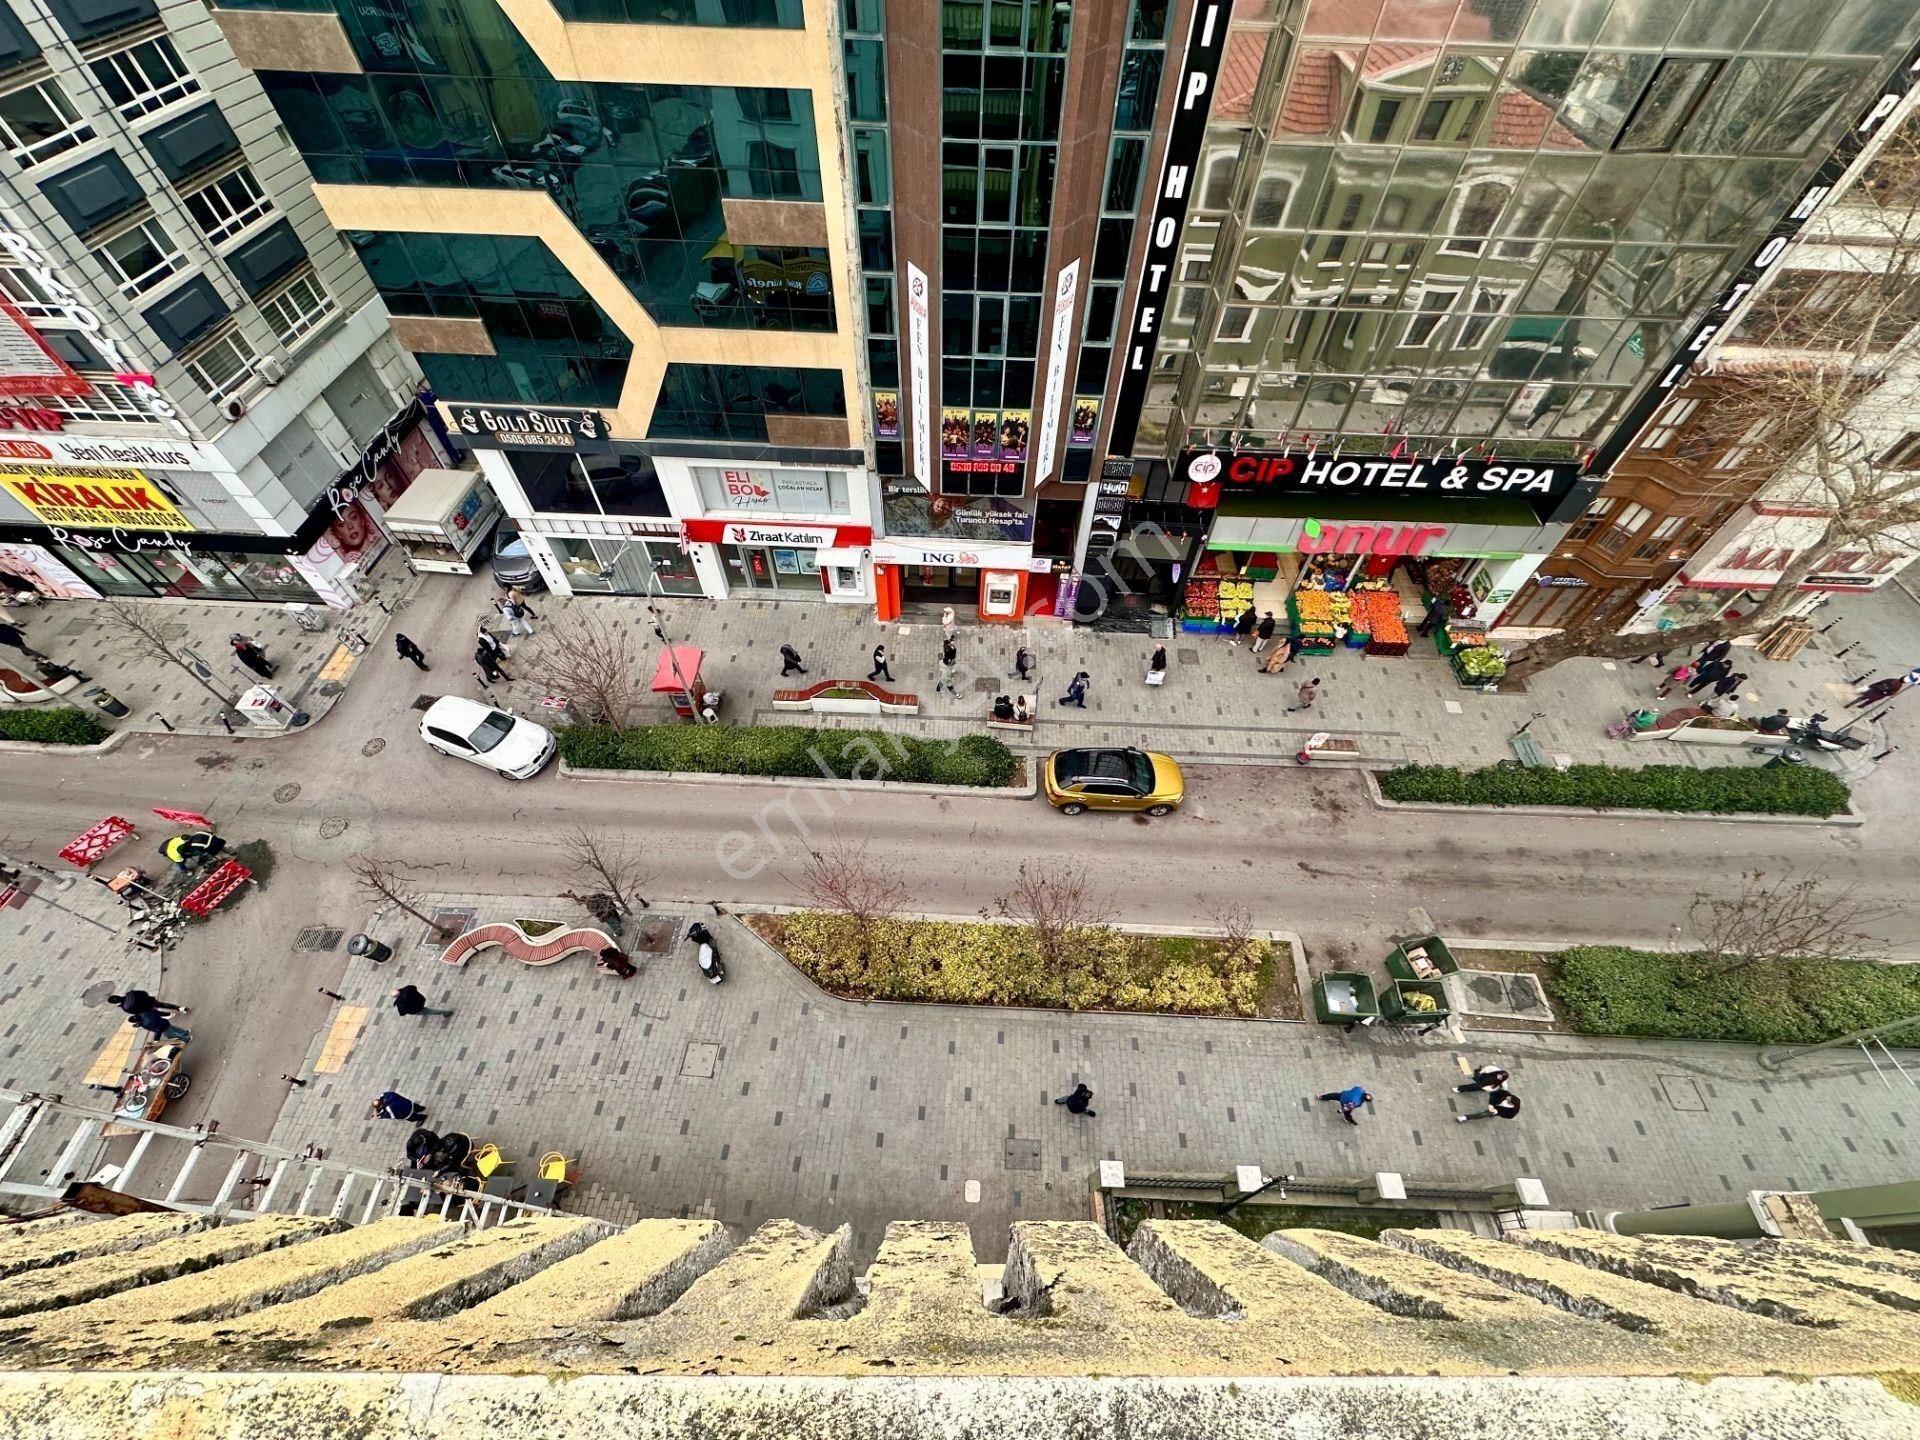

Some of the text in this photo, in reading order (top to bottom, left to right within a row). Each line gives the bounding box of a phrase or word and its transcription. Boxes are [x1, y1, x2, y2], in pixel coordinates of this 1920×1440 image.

[1131, 165, 1188, 370] HOTEL
[1659, 186, 1831, 388] HOTEL
[479, 409, 573, 434] GOLD SUIT
[545, 435, 558, 446] 24
[558, 436, 572, 447] 24
[58, 442, 105, 462] Yeni
[142, 446, 191, 466] Kurs
[888, 485, 901, 493] Bir
[1300, 460, 1430, 489] HOTEL
[1439, 465, 1468, 490] &
[1476, 466, 1555, 494] SPA
[11, 476, 167, 512] KİRALIK
[748, 530, 824, 544] Ziraat Katılım
[1296, 522, 1447, 556] onur
[922, 551, 955, 564] ING
